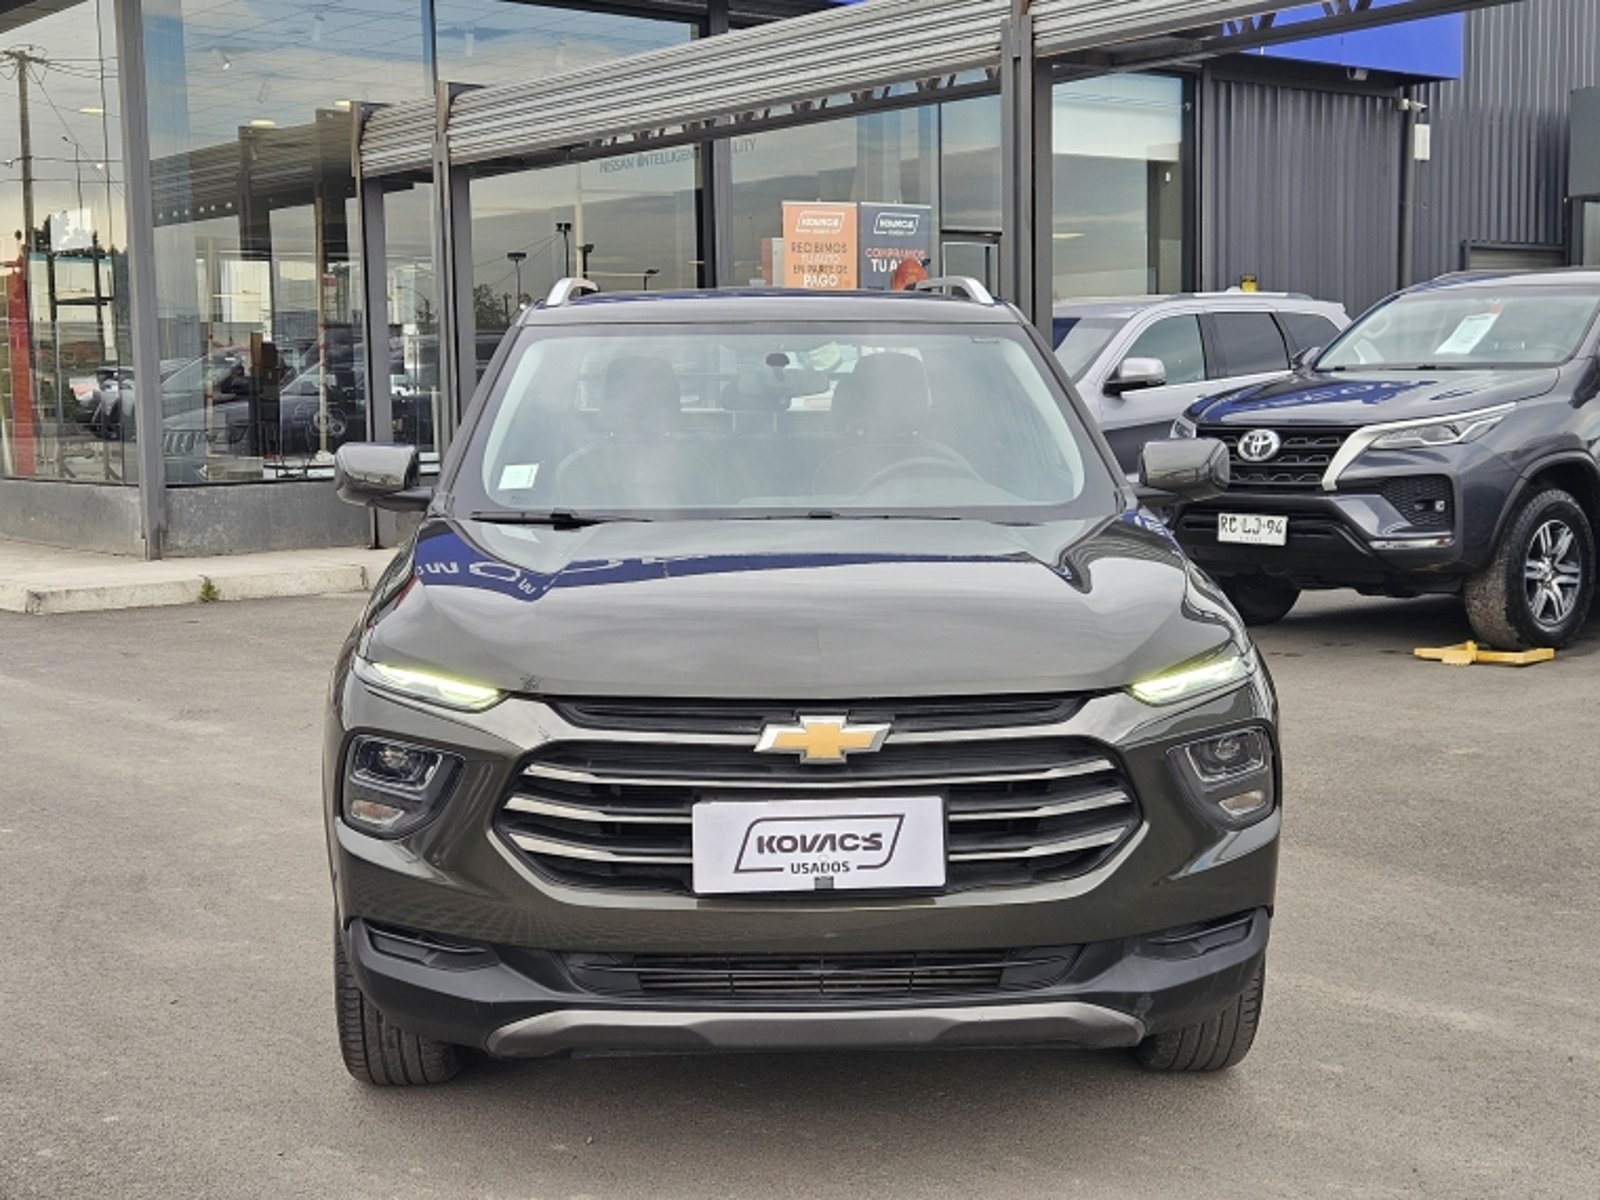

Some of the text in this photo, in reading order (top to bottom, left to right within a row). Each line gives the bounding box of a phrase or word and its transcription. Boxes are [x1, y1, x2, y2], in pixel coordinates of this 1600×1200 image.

[791, 241, 848, 254] RECIBIMOS
[871, 258, 887, 273] TU
[803, 274, 839, 288] PAGO
[756, 832, 883, 855] KOVACS
[791, 860, 851, 875] USADOS
